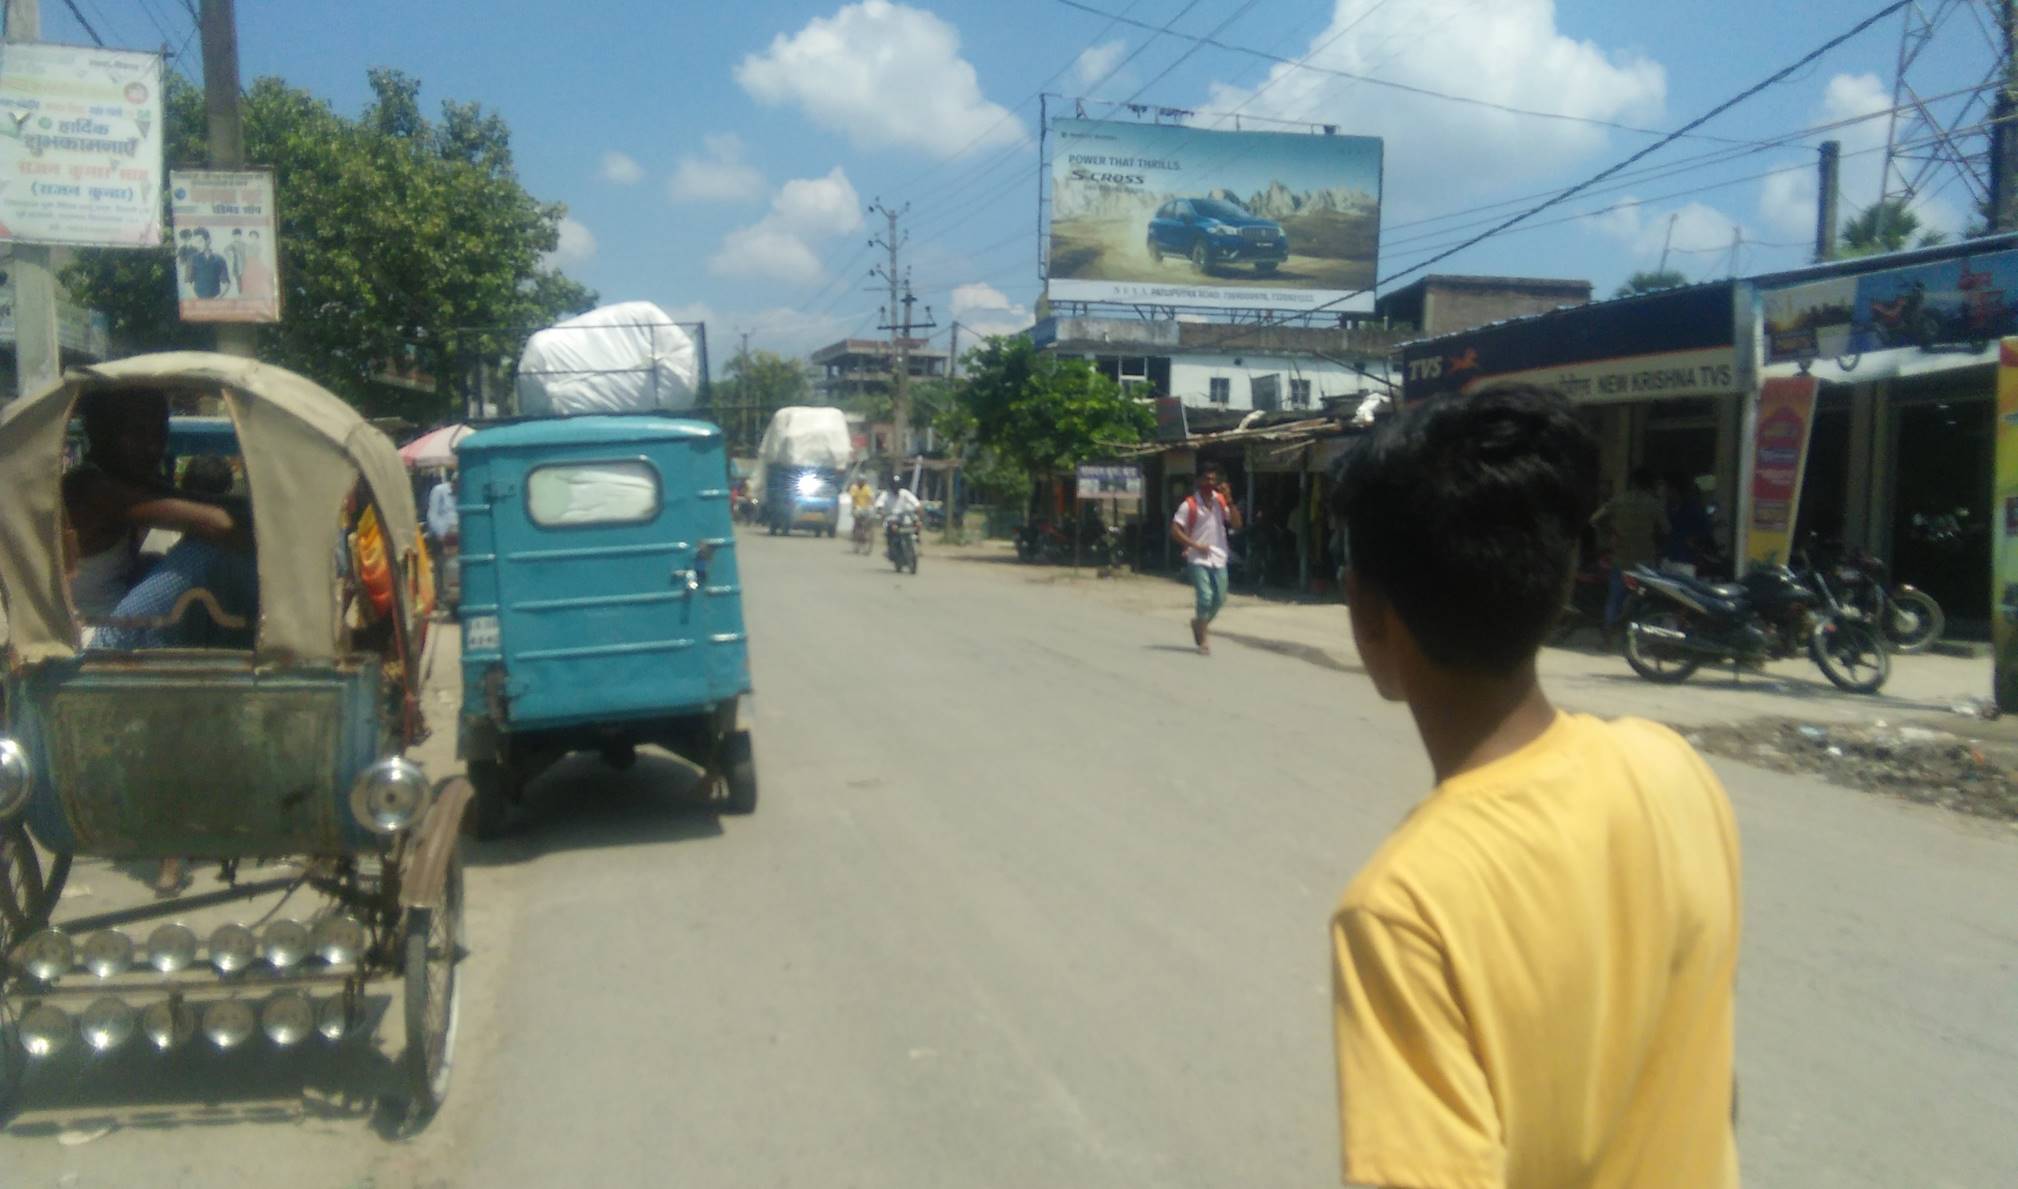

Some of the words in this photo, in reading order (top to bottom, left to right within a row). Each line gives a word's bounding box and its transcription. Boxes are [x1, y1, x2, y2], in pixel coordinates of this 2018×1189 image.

[1068, 154, 1107, 166] POWER
[1108, 156, 1136, 168] THAT
[1408, 355, 1443, 381] TVS
[1599, 374, 1629, 394] NEW
[1631, 367, 1697, 393] KRISHNA
[1699, 363, 1732, 386] TVS
